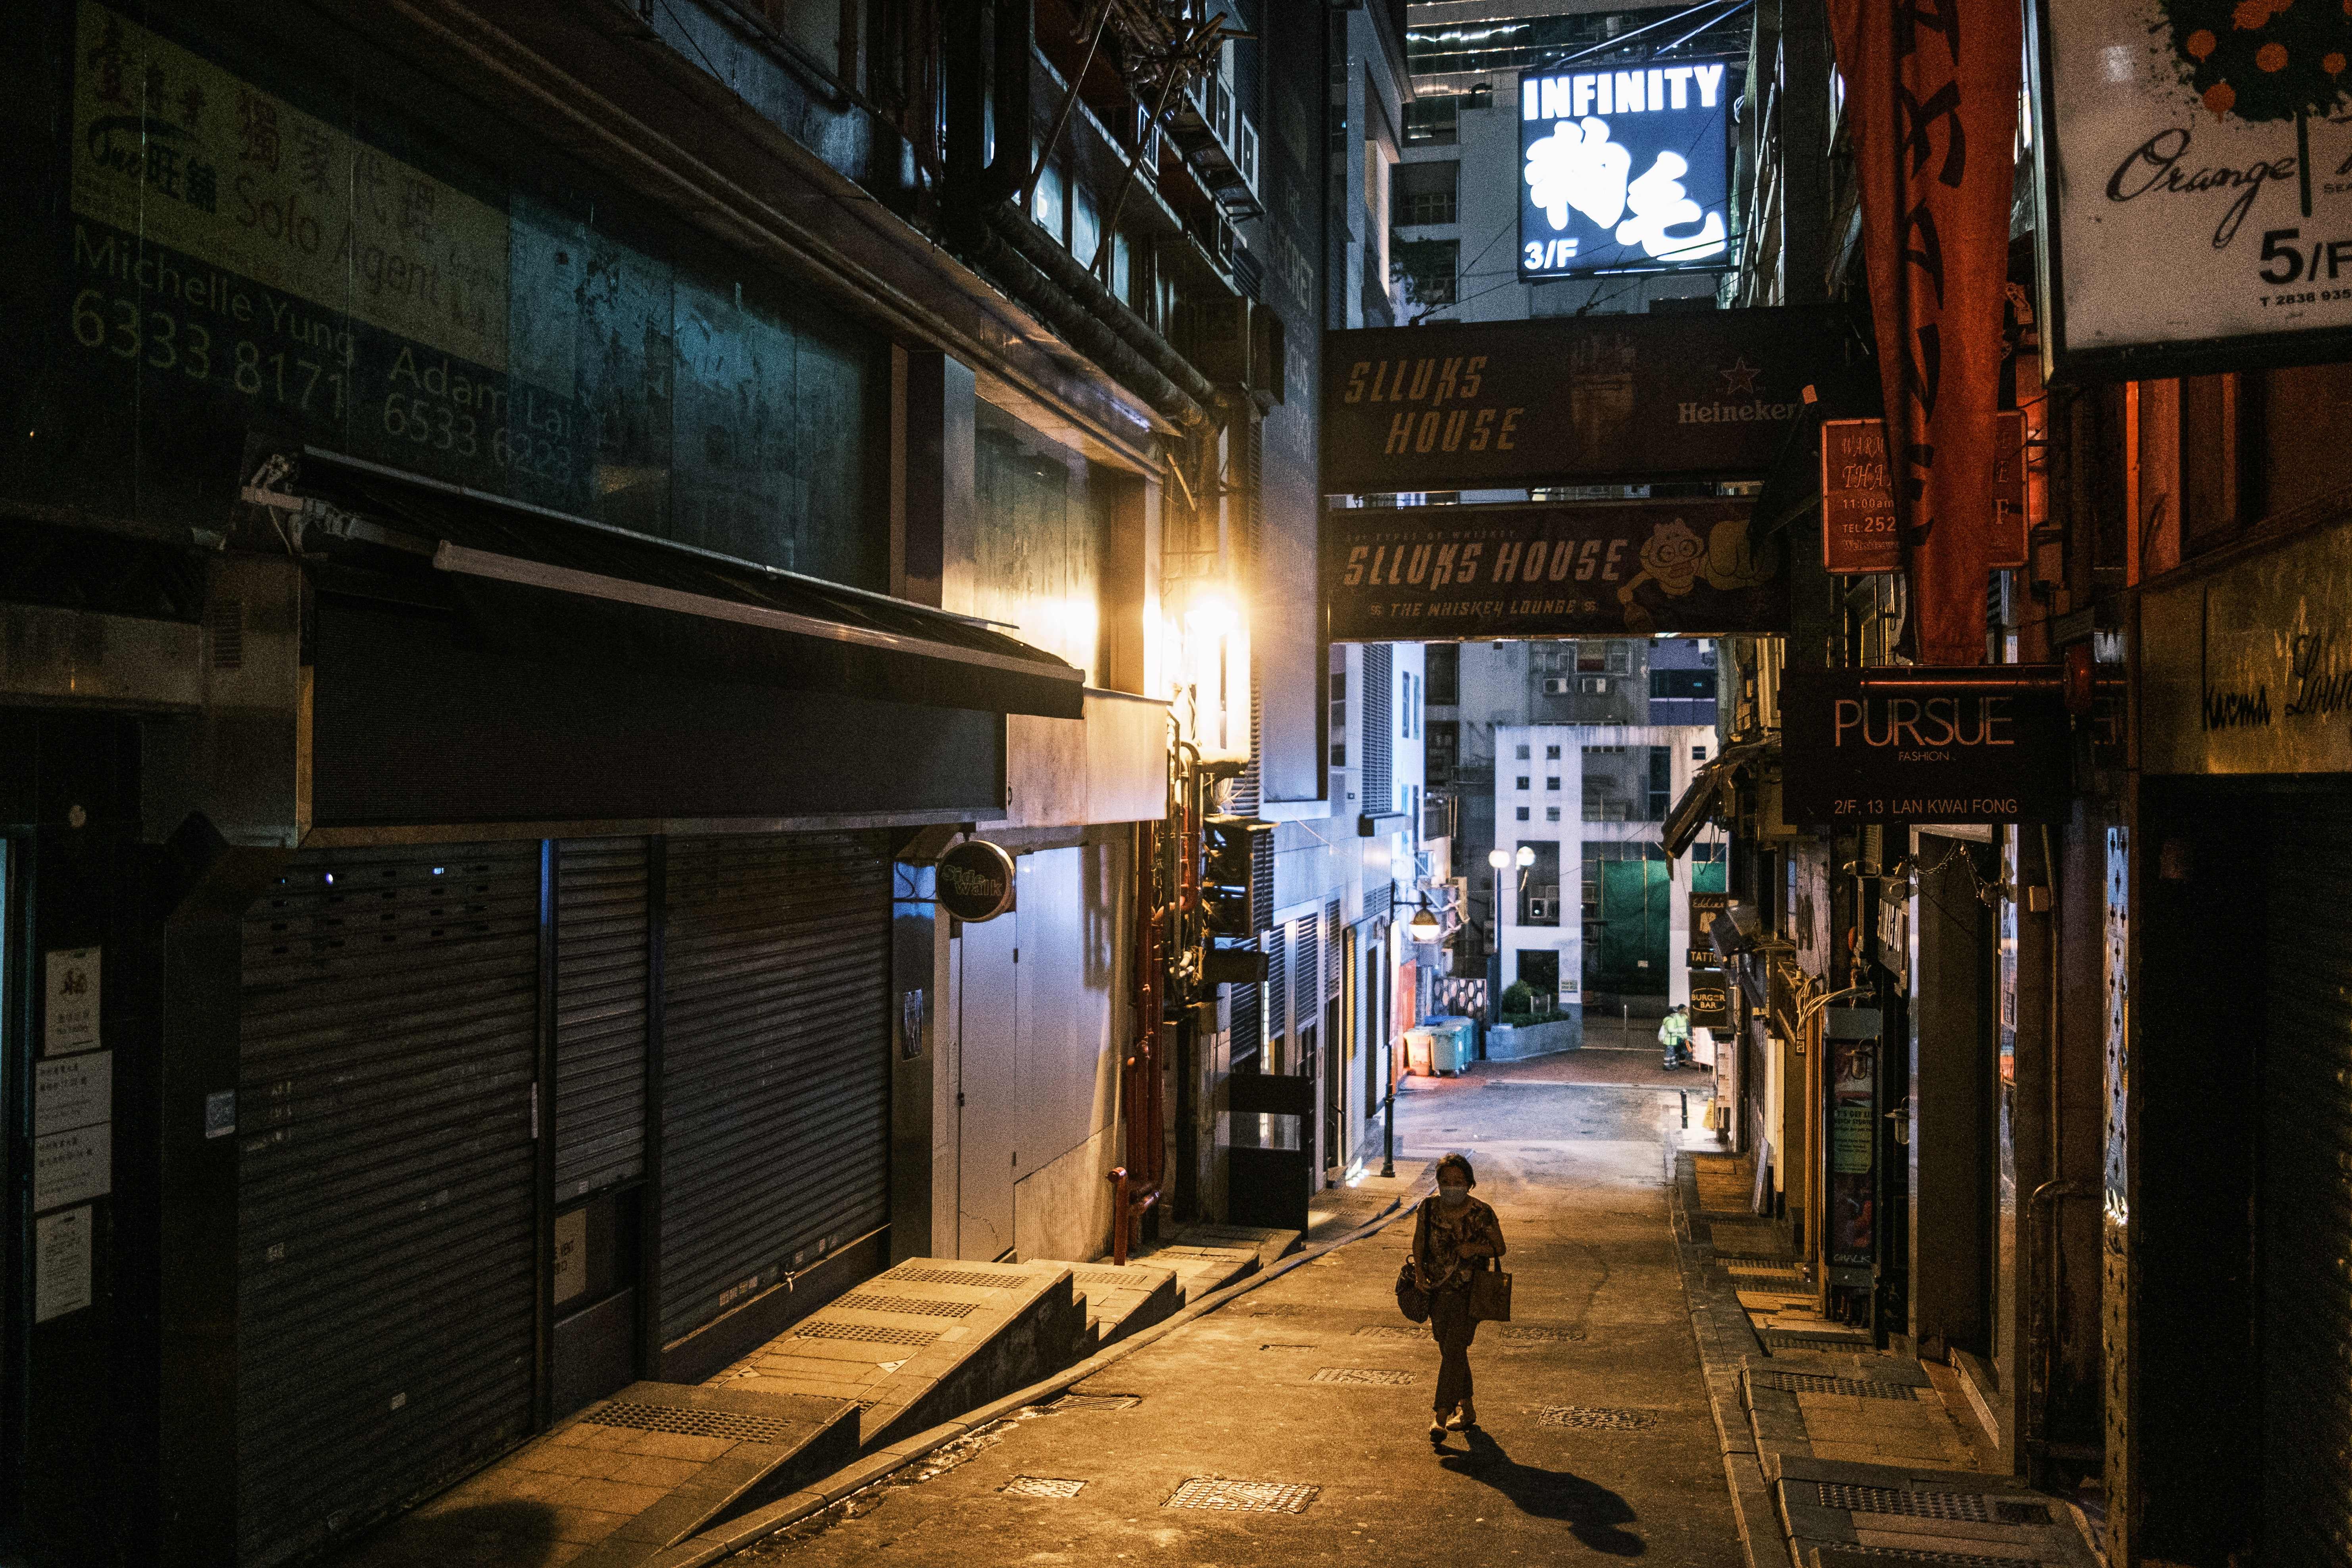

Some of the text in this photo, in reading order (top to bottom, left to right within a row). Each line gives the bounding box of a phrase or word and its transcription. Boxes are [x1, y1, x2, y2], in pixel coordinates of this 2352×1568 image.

[1523, 64, 1725, 121] INFINITY
[2105, 127, 2296, 249] Orange
[236, 175, 320, 253] Solo
[333, 221, 440, 305] Agent
[1523, 238, 1579, 270] 3/F
[75, 223, 254, 322] Michelle
[263, 291, 355, 367] Yung
[2260, 297, 2268, 307] T
[2276, 292, 2315, 306] 2838
[71, 288, 344, 419] 6333 8171
[389, 345, 571, 438] Adam Lai
[384, 391, 477, 457] 6533
[1385, 407, 1524, 454] HOUSE
[1491, 538, 1629, 583] HOUSE
[1390, 598, 1577, 618] THE WHISKEY LOUNGE
[1834, 696, 2016, 747] PURSUE
[1898, 751, 1950, 762] FASHION
[1833, 798, 2019, 816] 2/F, 13 LAN KWAI FONG
[954, 878, 1003, 897] walk
